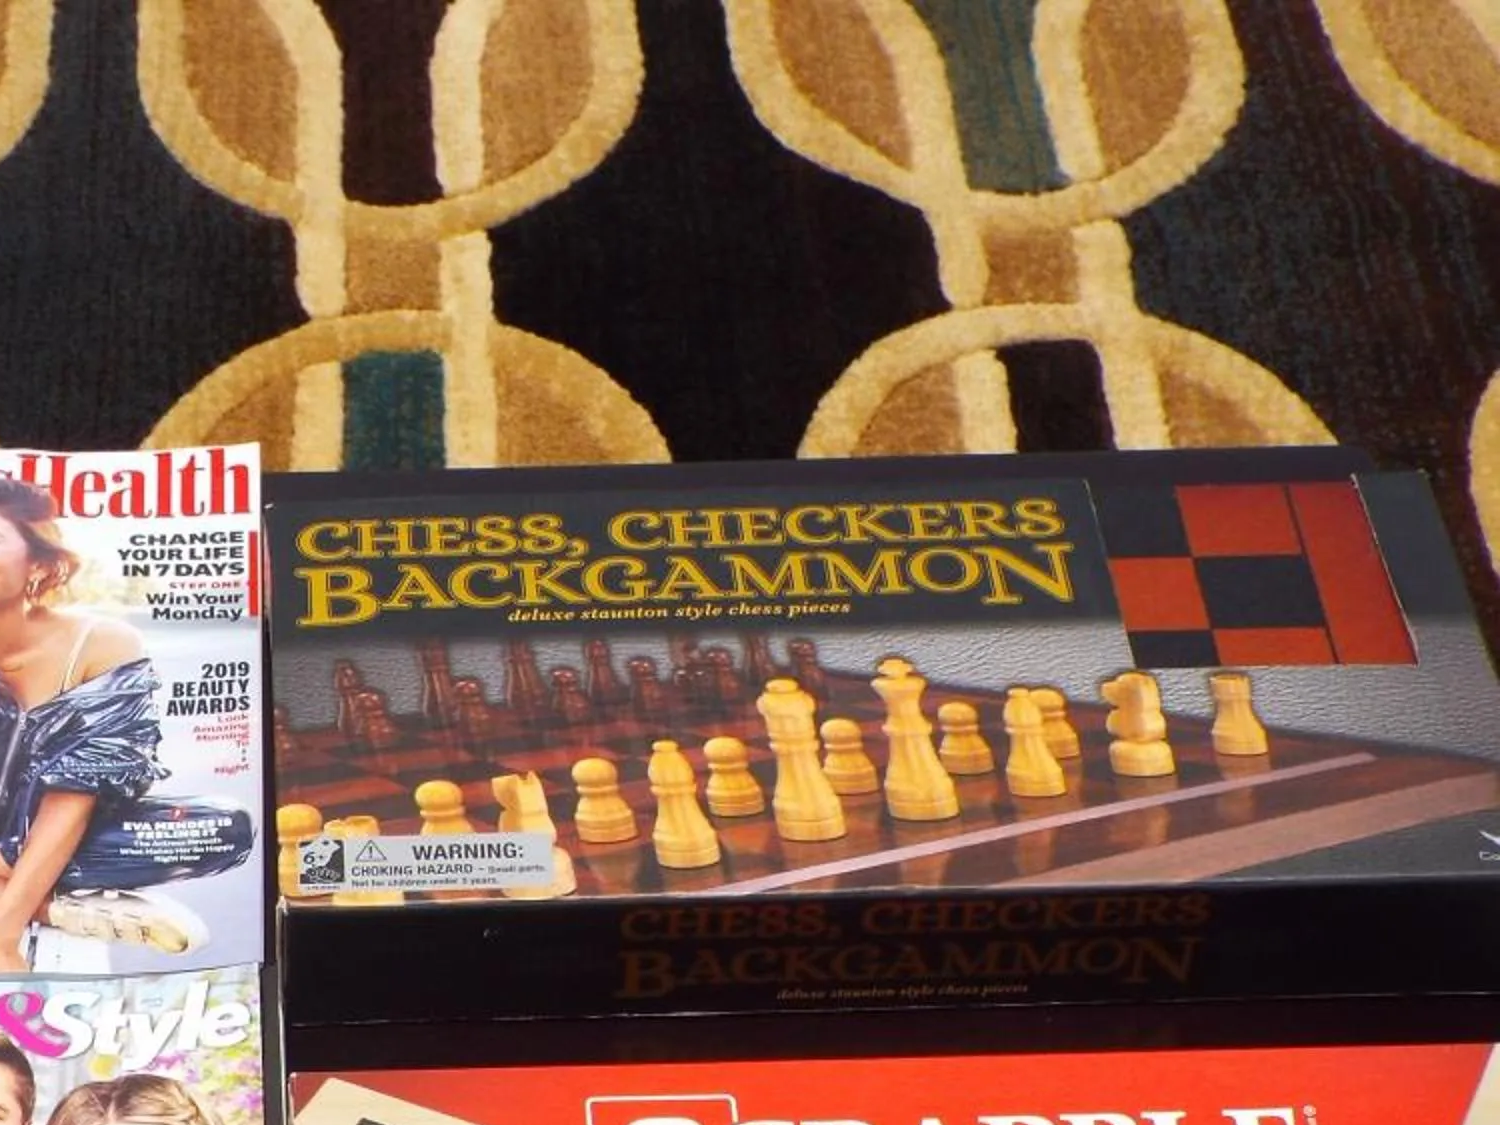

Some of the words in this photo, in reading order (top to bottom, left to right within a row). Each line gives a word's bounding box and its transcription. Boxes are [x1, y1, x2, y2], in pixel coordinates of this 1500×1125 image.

[17, 448, 251, 519] Health
[129, 531, 244, 547] CHANGE
[295, 513, 589, 560] CHESS,
[608, 498, 1064, 551] CHECKERS
[118, 548, 183, 561] YOUR
[188, 546, 245, 560] LIFE
[122, 564, 150, 577] IN
[172, 562, 245, 577] DAYS
[295, 542, 1074, 628] BACKGAMMON
[152, 606, 244, 622] Monday
[508, 607, 575, 623] deluxe
[580, 605, 668, 619] staunton
[675, 603, 723, 620] style
[729, 602, 782, 616] chess
[788, 601, 851, 618] pieces
[202, 661, 250, 679] 2019
[172, 678, 250, 699] BEAUTY
[166, 696, 250, 717] AWARDS
[412, 842, 524, 861] WARNING:
[352, 865, 413, 877] CHOKING
[417, 864, 473, 876] HAZARD
[861, 893, 1211, 935] CHECKERS
[613, 937, 1203, 1000] BACKGAMMON
